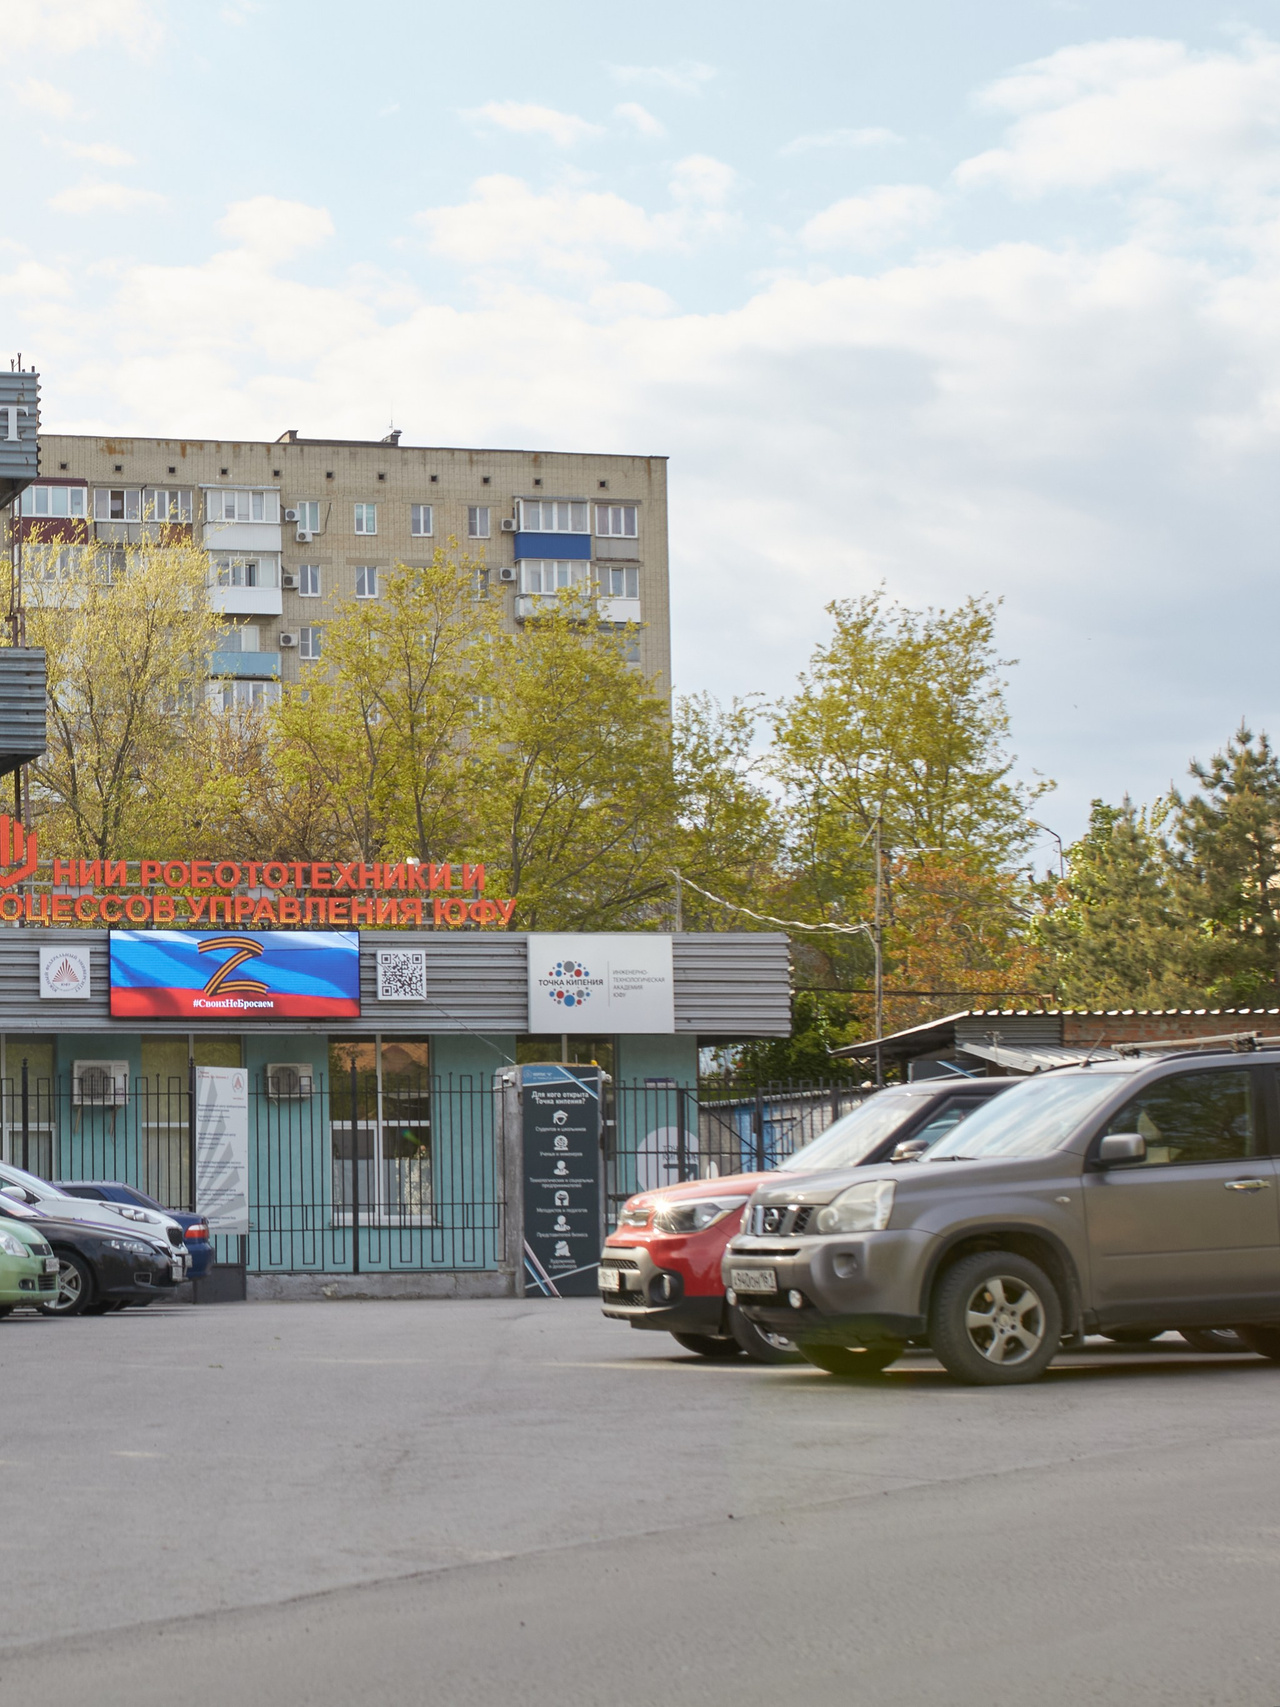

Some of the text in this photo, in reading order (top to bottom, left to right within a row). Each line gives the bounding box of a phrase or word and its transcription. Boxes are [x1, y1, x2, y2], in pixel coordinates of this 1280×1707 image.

[53, 859, 485, 891] НИИ РОБОТОТЕХНИКИ И
[185, 896, 422, 925] УПРАВЛЕНИЯ
[433, 898, 517, 925] ЮФУ
[193, 999, 274, 1009] #СвоихНеБросаем
